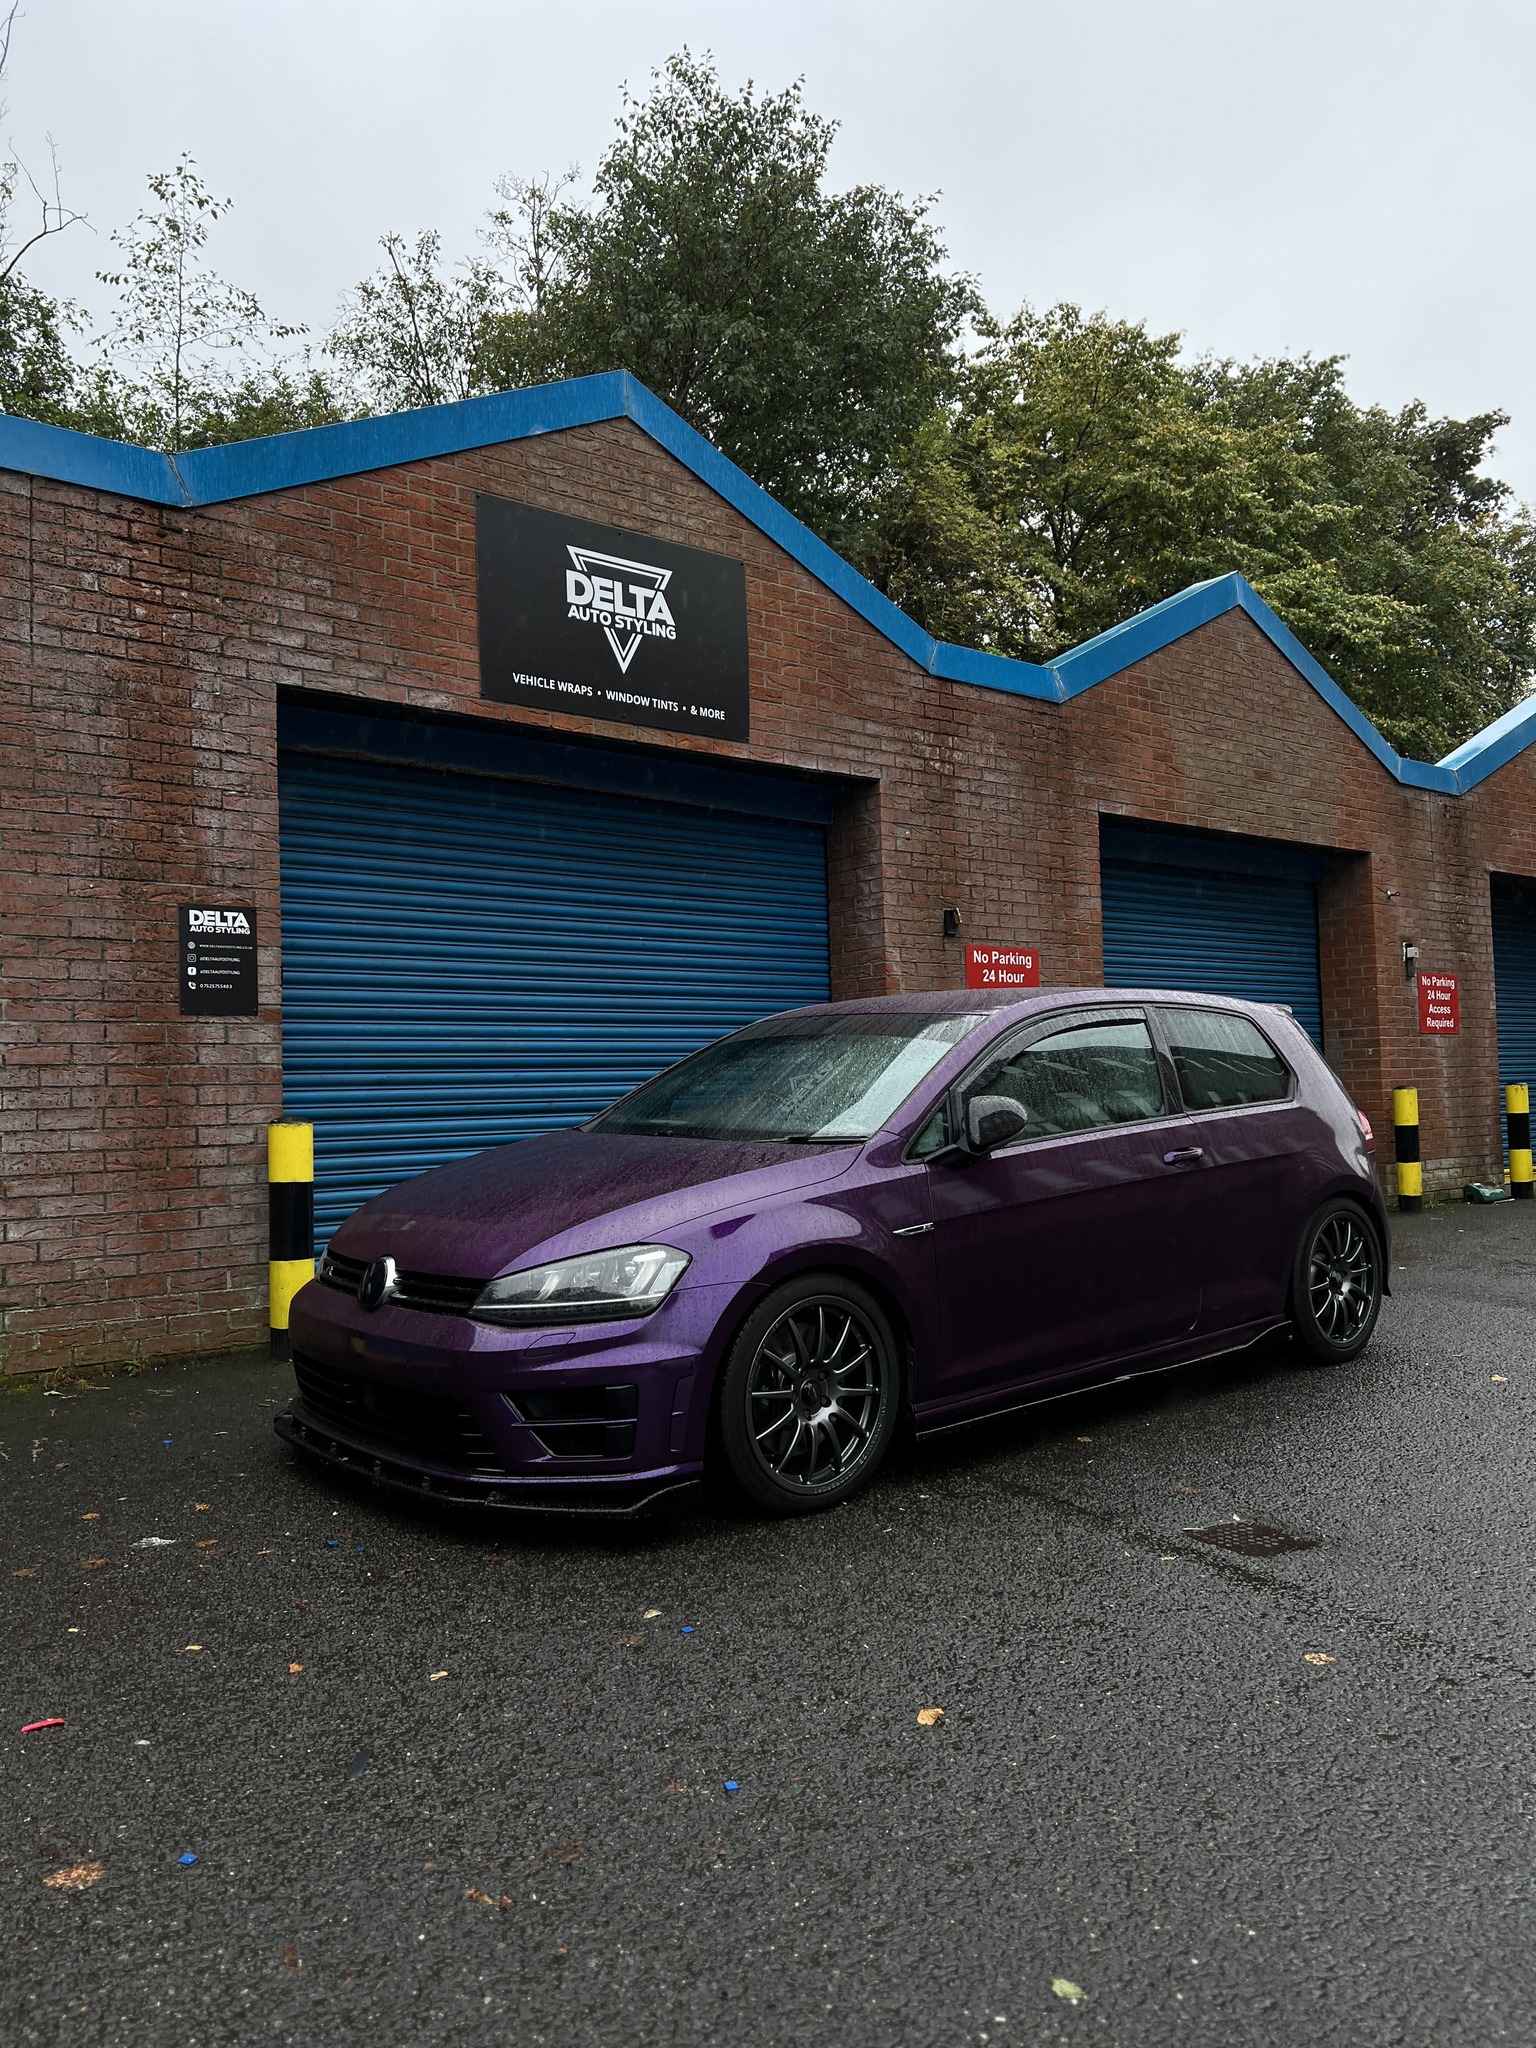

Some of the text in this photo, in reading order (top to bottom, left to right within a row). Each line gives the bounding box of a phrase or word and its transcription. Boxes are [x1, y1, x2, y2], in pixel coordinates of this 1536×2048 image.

[566, 570, 675, 625] DELTA
[568, 605, 677, 640] AUTO STYLING
[513, 673, 726, 721] VEHICLE WRAPS WINDOW TINTS & MORE
[189, 910, 249, 927] DELTA
[215, 926, 251, 935] STYLING
[974, 950, 1032, 969] No Parking
[982, 969, 1024, 983] 24 Hour
[1421, 975, 1455, 990] No Parking
[1427, 989, 1452, 1001] 24 Hour
[1428, 1003, 1451, 1014] Access
[1426, 1017, 1454, 1029] Required
